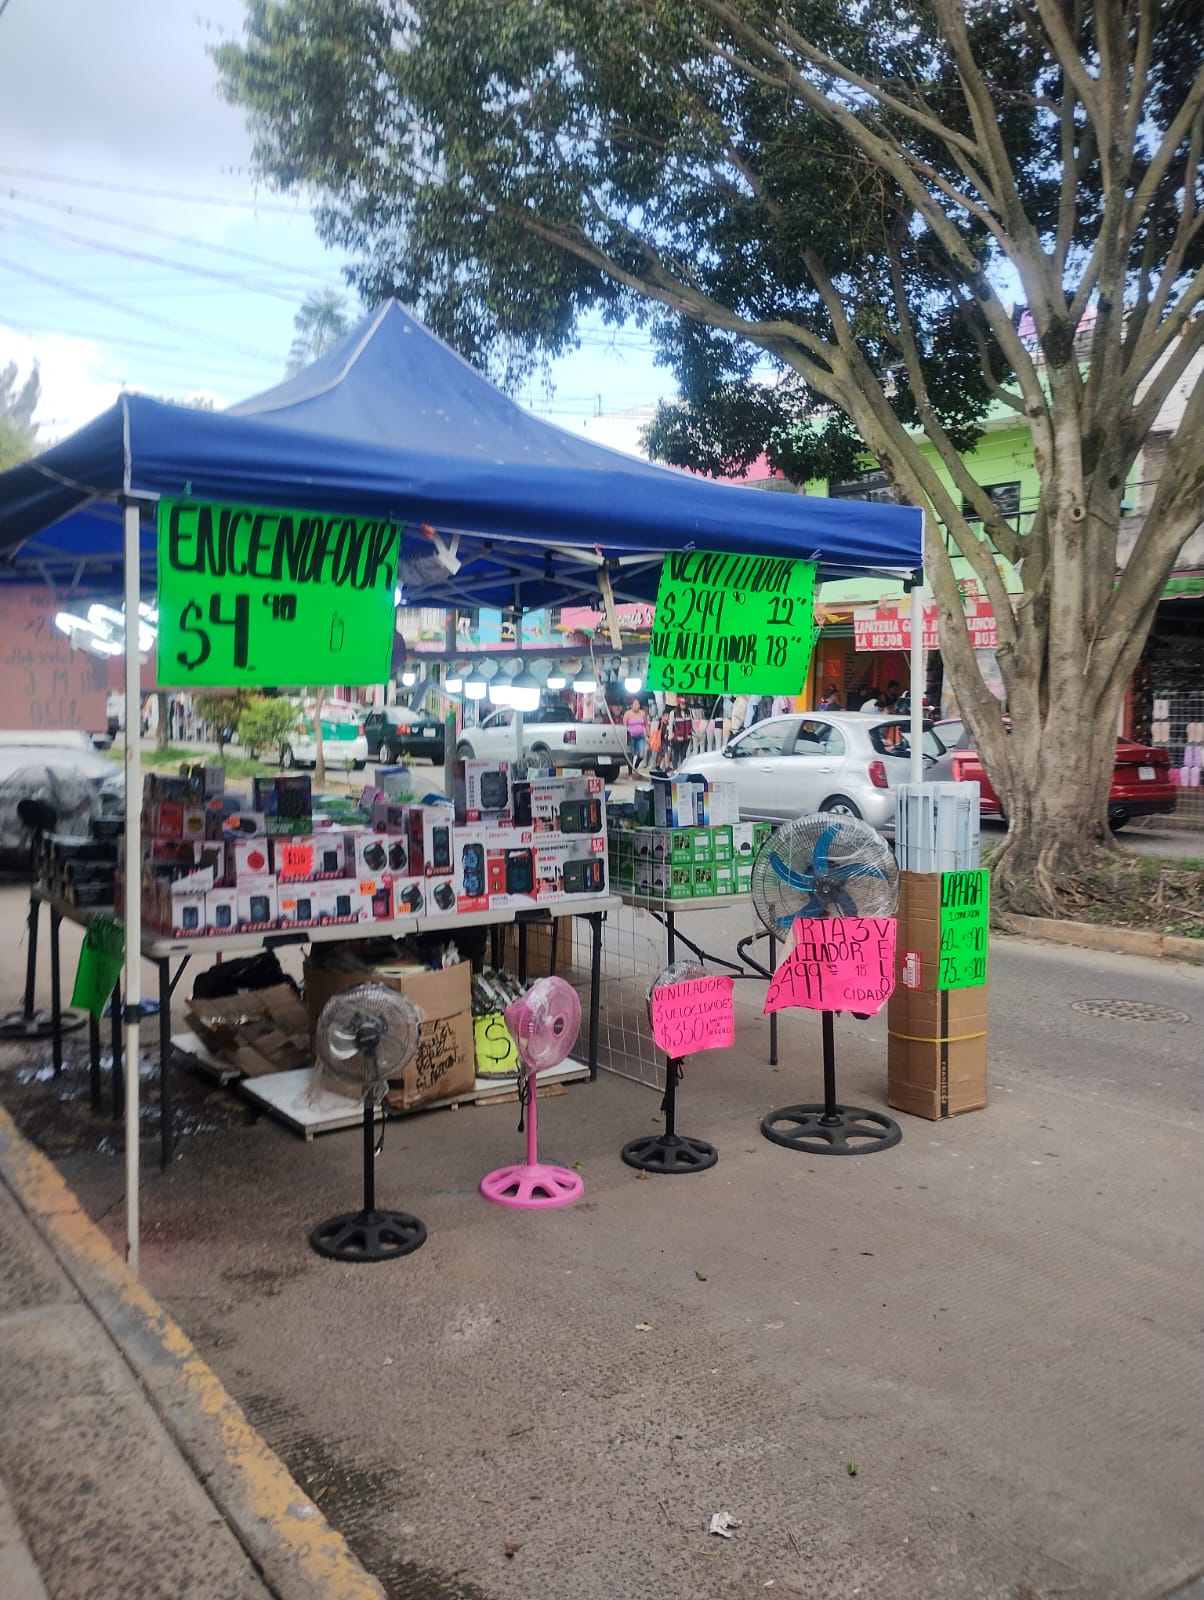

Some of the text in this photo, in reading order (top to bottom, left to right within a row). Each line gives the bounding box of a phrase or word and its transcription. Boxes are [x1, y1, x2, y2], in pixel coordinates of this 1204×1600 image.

[660, 587, 726, 634] $299
[854, 619, 899, 634] ZAPATERIA
[855, 634, 868, 647] LA
[871, 633, 903, 647] MEJOR
[653, 632, 758, 667] VENTILADOR
[661, 662, 730, 692] $399
[851, 918, 870, 943] 3
[654, 978, 727, 1002] VENTILADOR
[661, 1017, 704, 1050] $350
